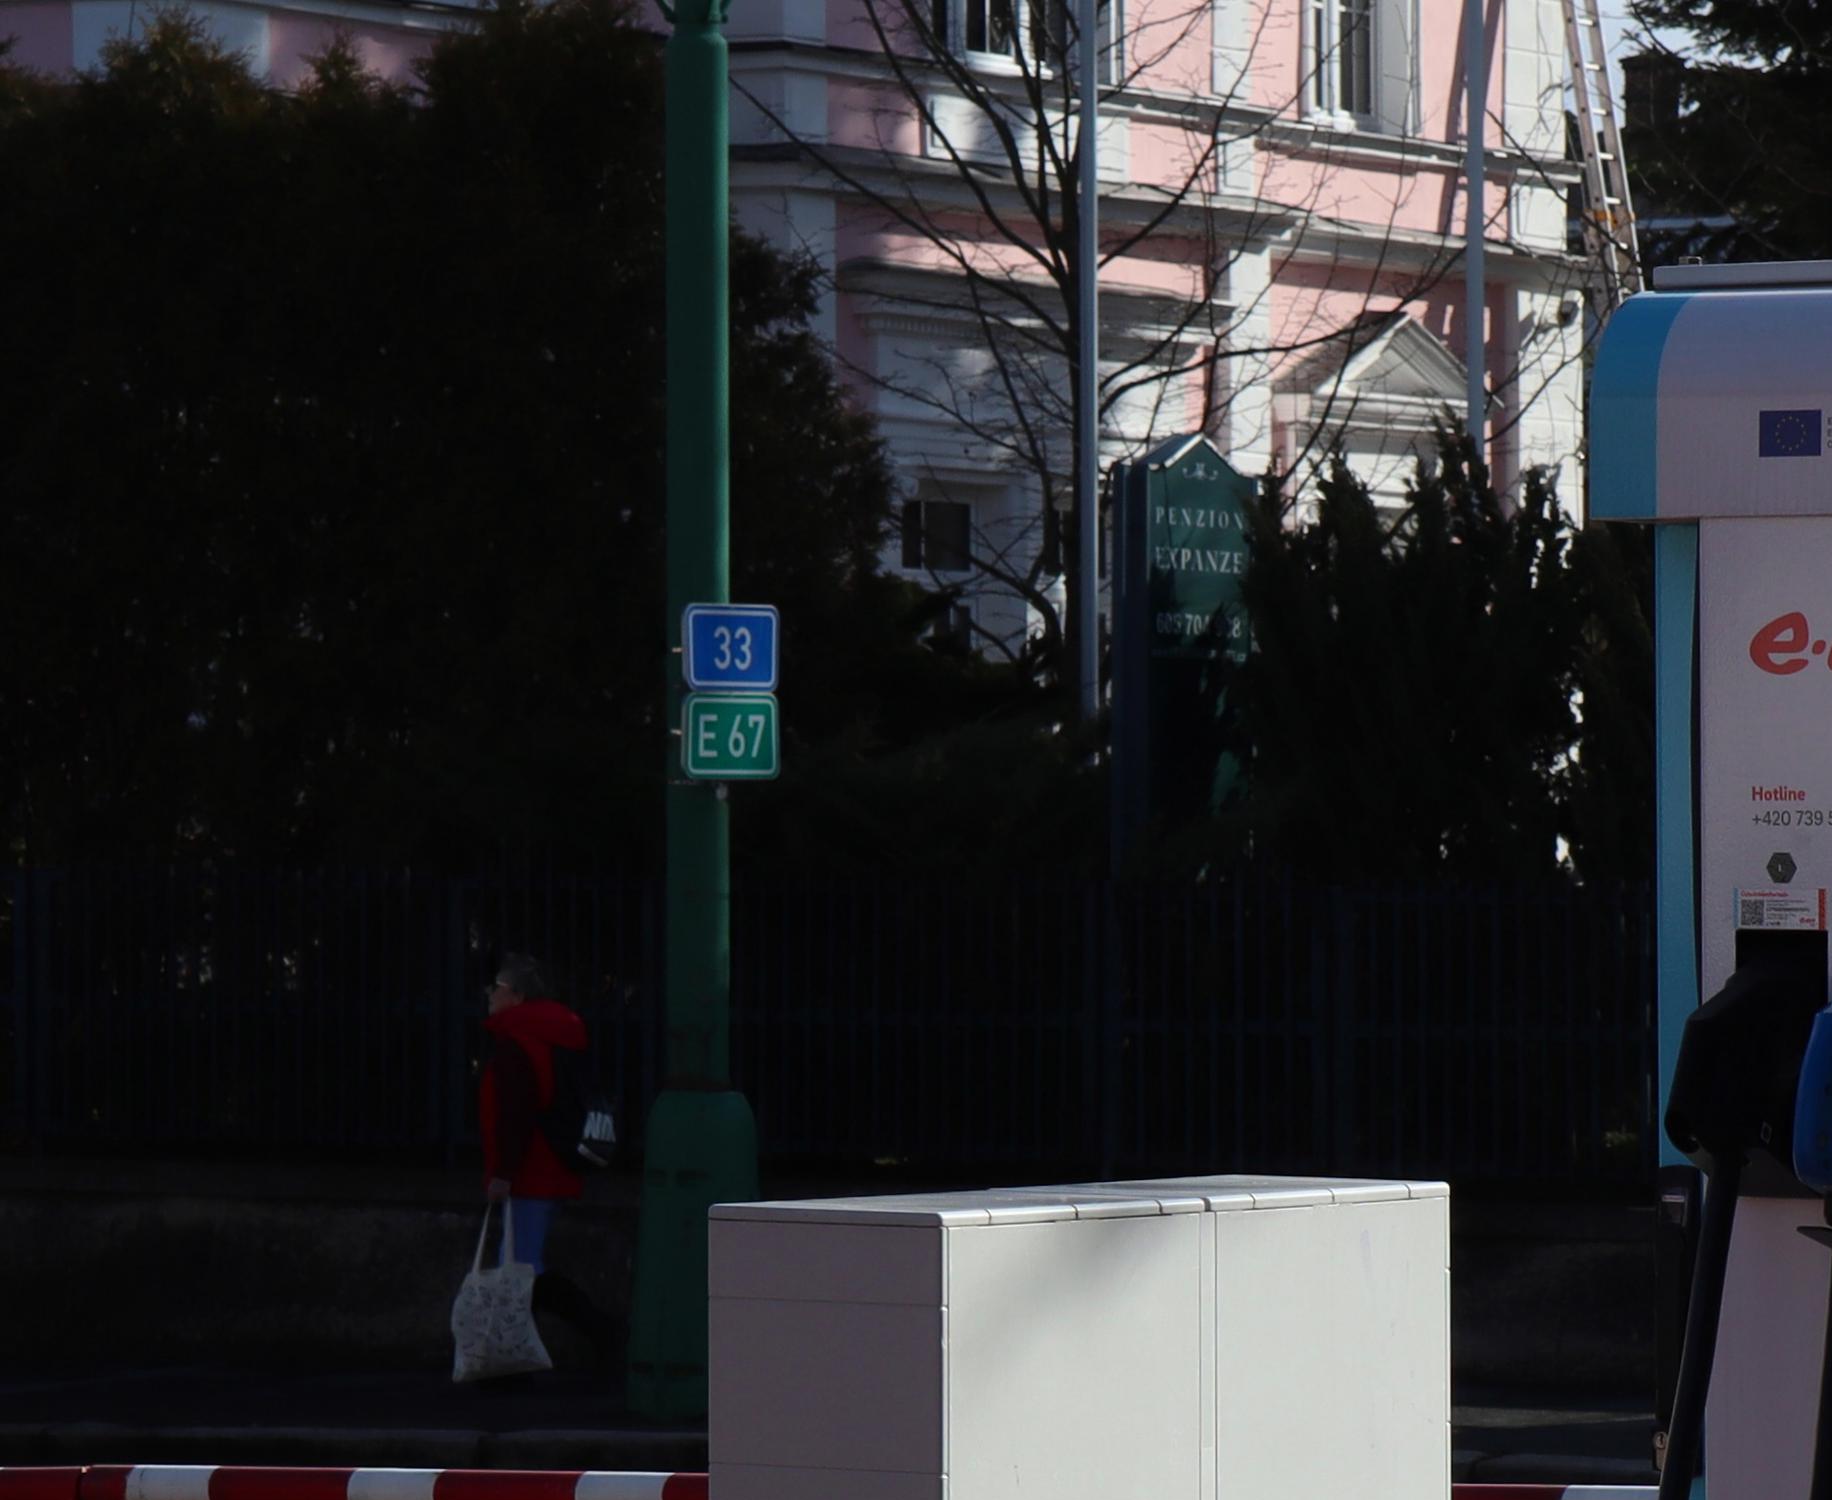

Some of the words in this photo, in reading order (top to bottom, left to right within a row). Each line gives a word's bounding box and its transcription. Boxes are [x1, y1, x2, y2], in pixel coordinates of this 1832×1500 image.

[1155, 506, 1245, 531] PENZION
[1154, 546, 1243, 575] EXPANZE
[713, 626, 752, 670] 33
[698, 714, 718, 758] E
[728, 714, 766, 758] 67
[1752, 786, 1806, 801] Hotline
[1752, 810, 1791, 826] +420
[1795, 810, 1823, 826] 739
